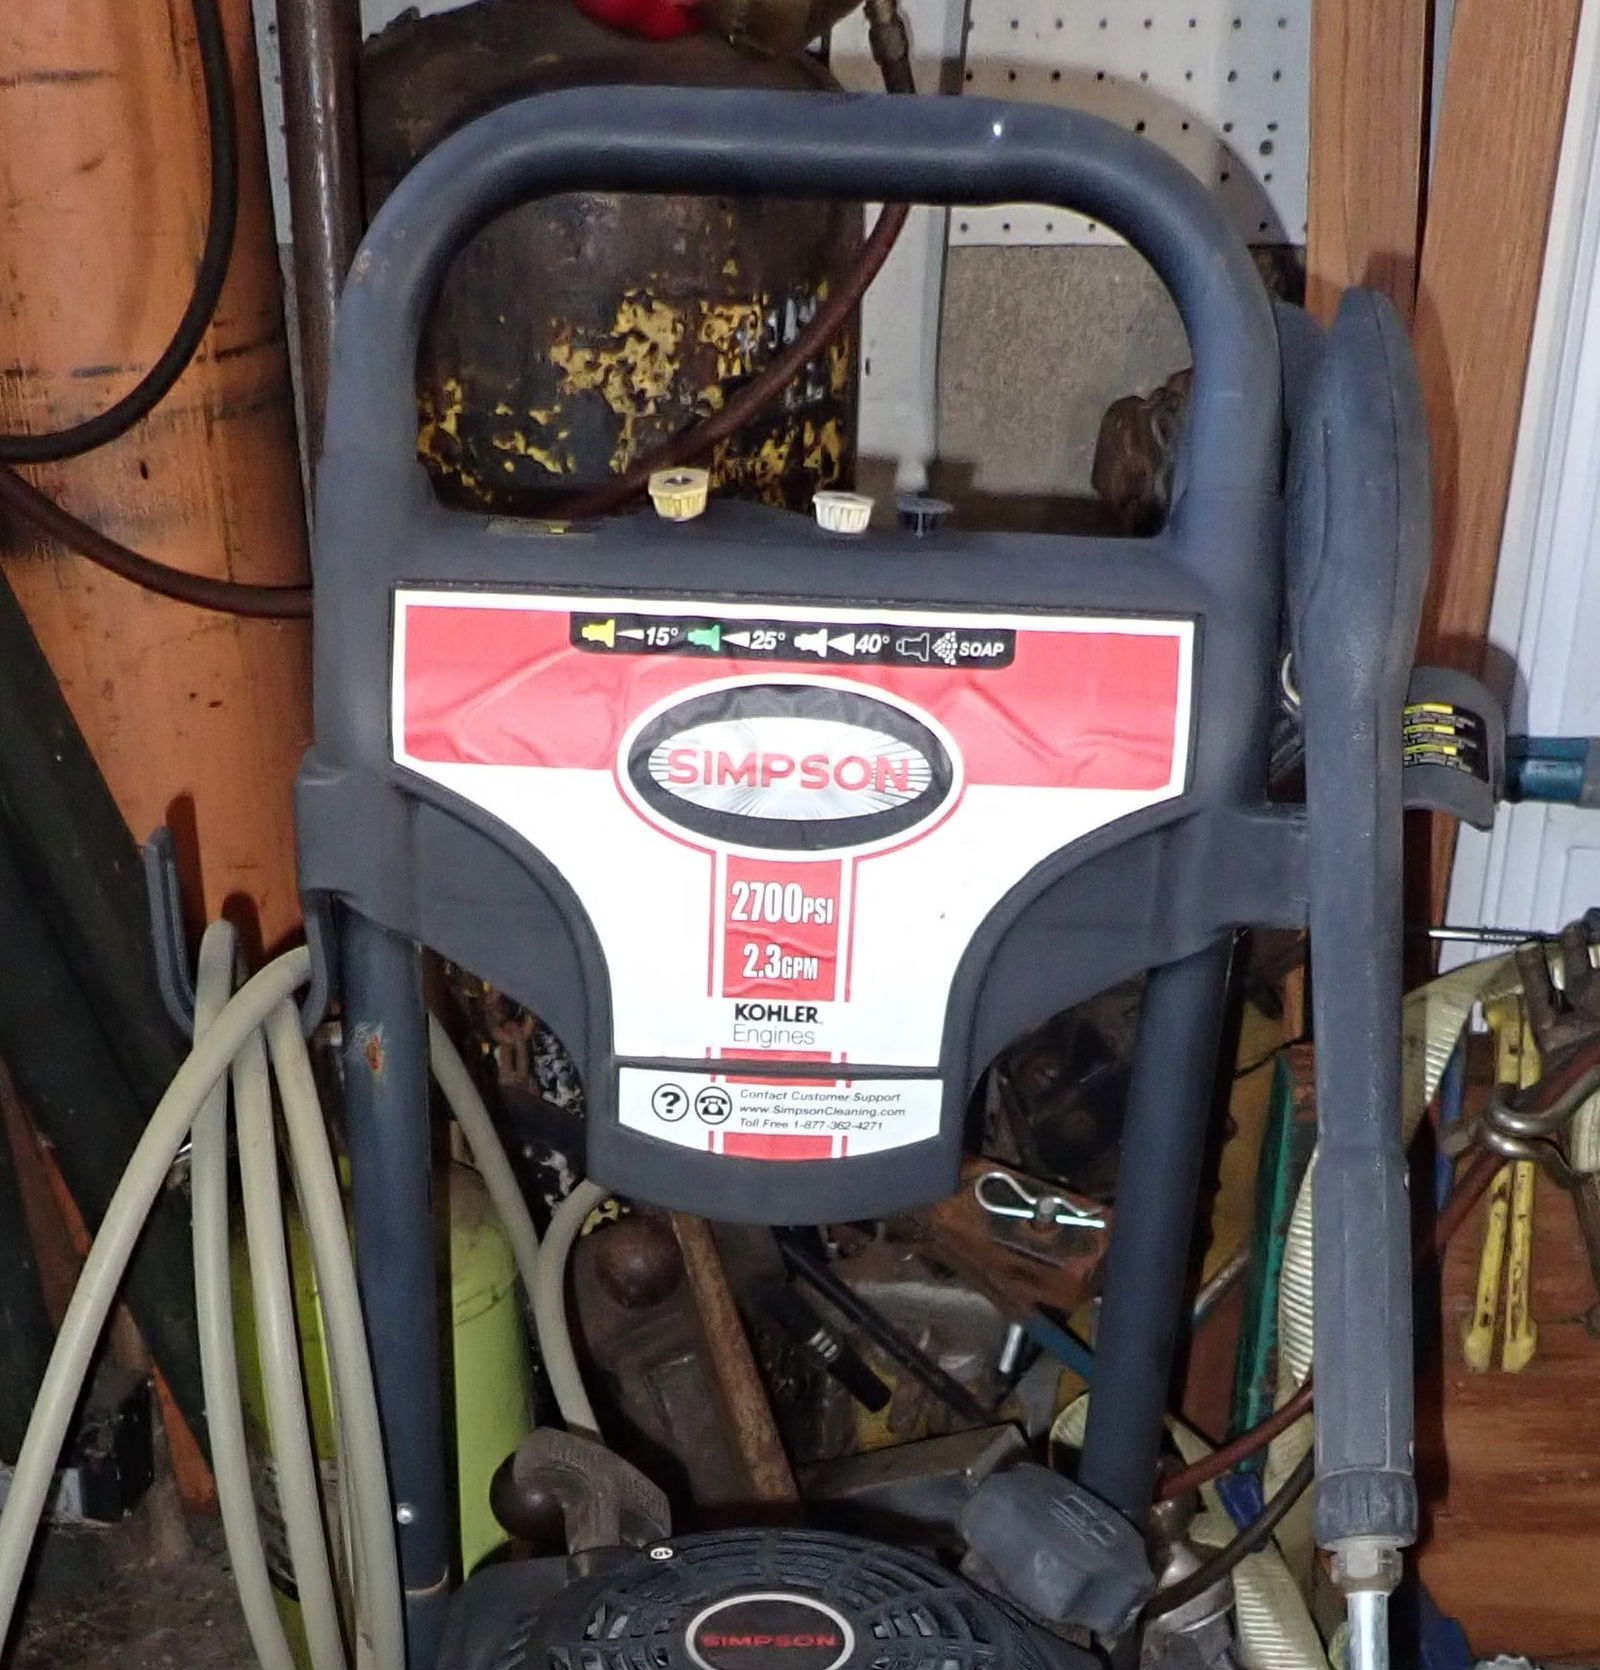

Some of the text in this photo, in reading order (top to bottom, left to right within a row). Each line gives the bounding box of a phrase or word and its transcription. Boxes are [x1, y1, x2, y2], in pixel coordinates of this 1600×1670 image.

[959, 642, 1005, 657] SOAP
[668, 749, 911, 792] SIMPSON
[734, 1003, 818, 1023] KOHLER
[733, 1023, 816, 1048] Engines
[740, 1089, 901, 1104] Contact Customer Support
[740, 1105, 905, 1118] www.SimpsonCleaning.com
[740, 1118, 883, 1131] Toll Free 1-877-362-4271
[701, 1633, 837, 1648] SIMPSON
